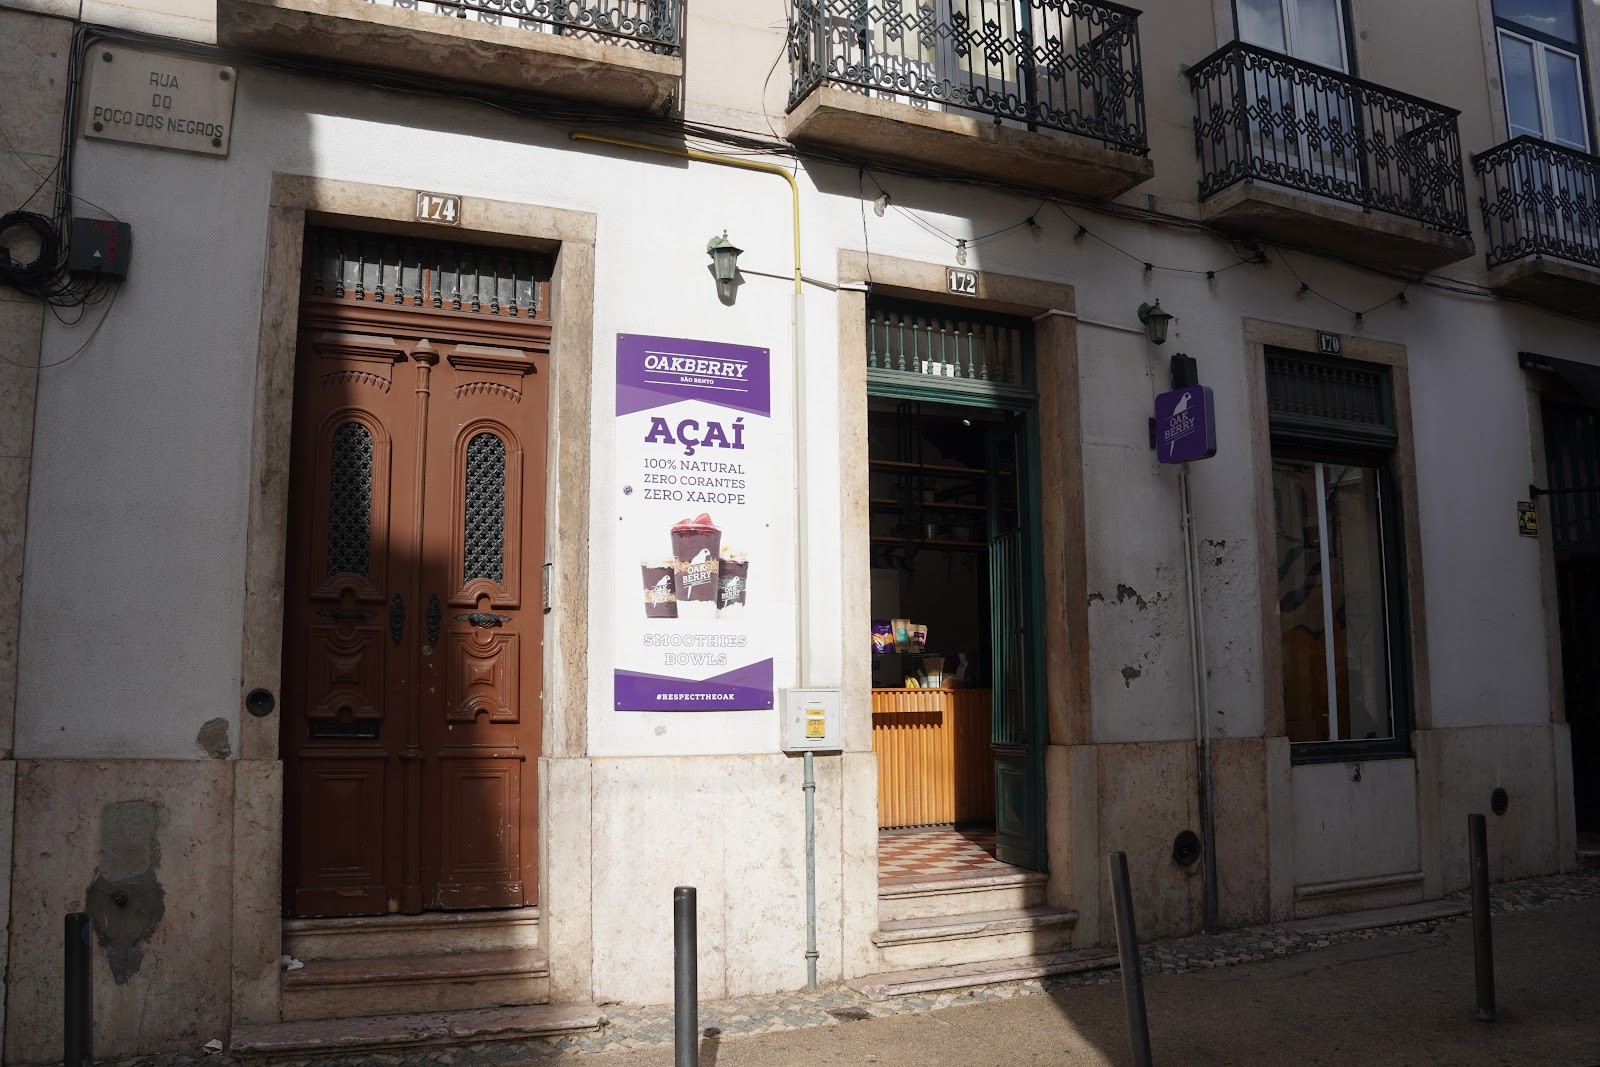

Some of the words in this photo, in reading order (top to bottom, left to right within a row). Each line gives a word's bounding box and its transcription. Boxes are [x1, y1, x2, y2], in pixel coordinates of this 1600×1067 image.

[150, 72, 179, 89] RUA
[152, 94, 172, 109] DO
[135, 113, 164, 130] DOS
[167, 117, 224, 138] NEGROS
[420, 196, 456, 221] 174
[949, 271, 976, 293] 172
[1320, 334, 1340, 352] 170
[644, 355, 748, 378] OAKBERRY
[1169, 411, 1190, 427] OAK
[644, 416, 745, 456] AÇAÍ
[1164, 417, 1195, 439] BERRY
[644, 458, 677, 470] 100%
[680, 460, 745, 475] NATURAL
[644, 473, 677, 485] ZERO
[680, 476, 746, 489] CORANTES
[644, 488, 683, 502] ZERO
[686, 491, 746, 505] XAROPE
[682, 571, 712, 584] BERRY
[687, 564, 706, 575] OAK
[643, 633, 747, 648] SMOOTHIES
[664, 652, 728, 666] BOWLS
[656, 693, 735, 701] #RESPECTTHEOAK
